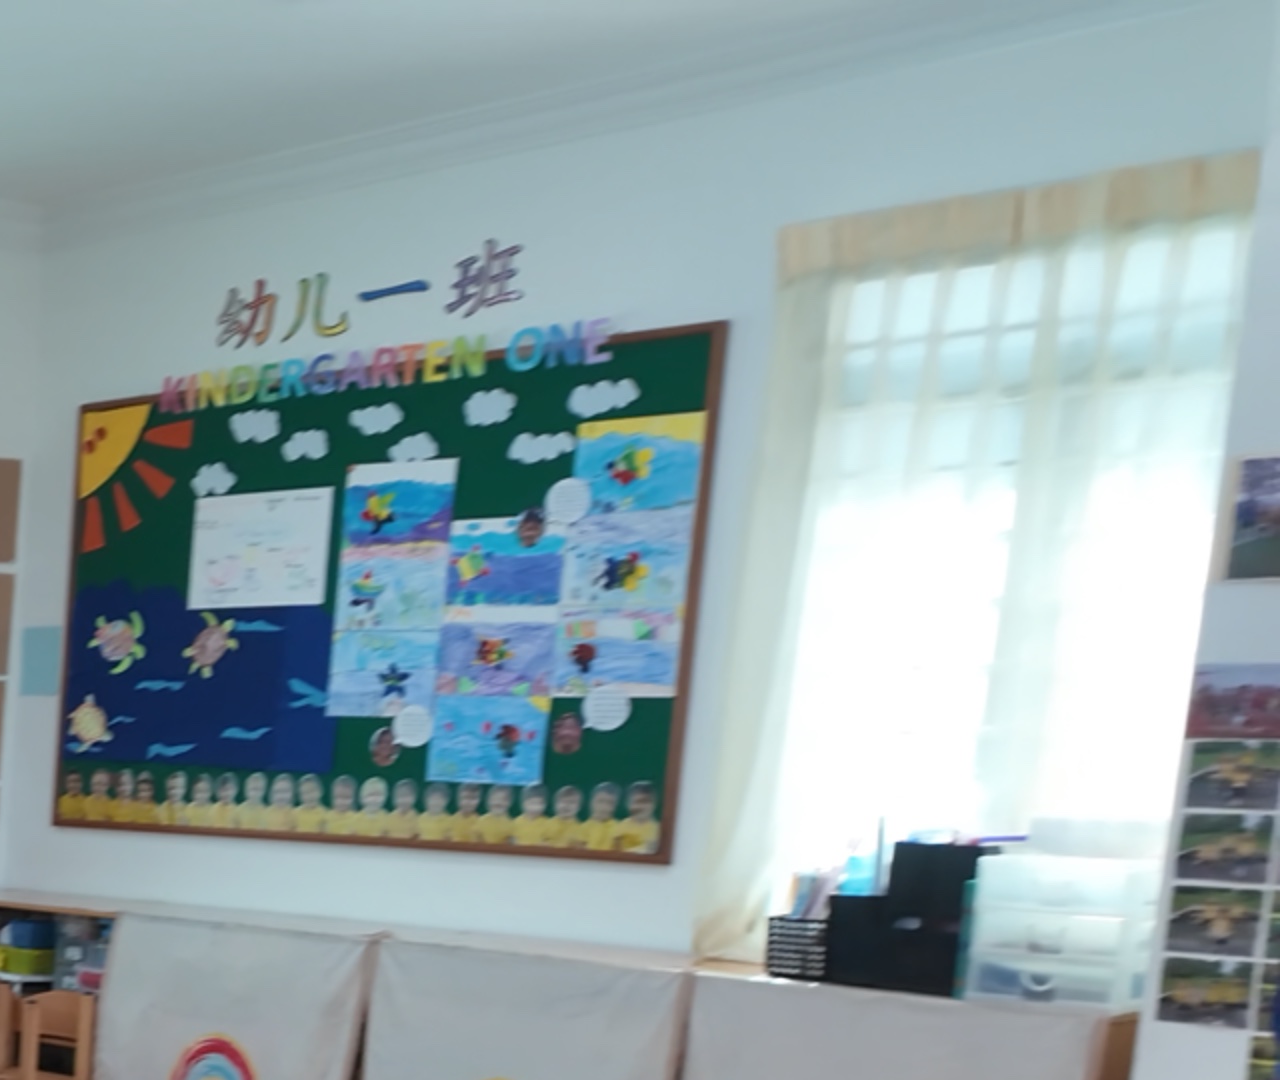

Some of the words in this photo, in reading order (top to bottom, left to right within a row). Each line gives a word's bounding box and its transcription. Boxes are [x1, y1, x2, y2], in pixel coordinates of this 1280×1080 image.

[215, 238, 525, 349] 幼儿一班
[157, 333, 487, 414] KINDERGARTEN
[504, 317, 614, 373] ONE
